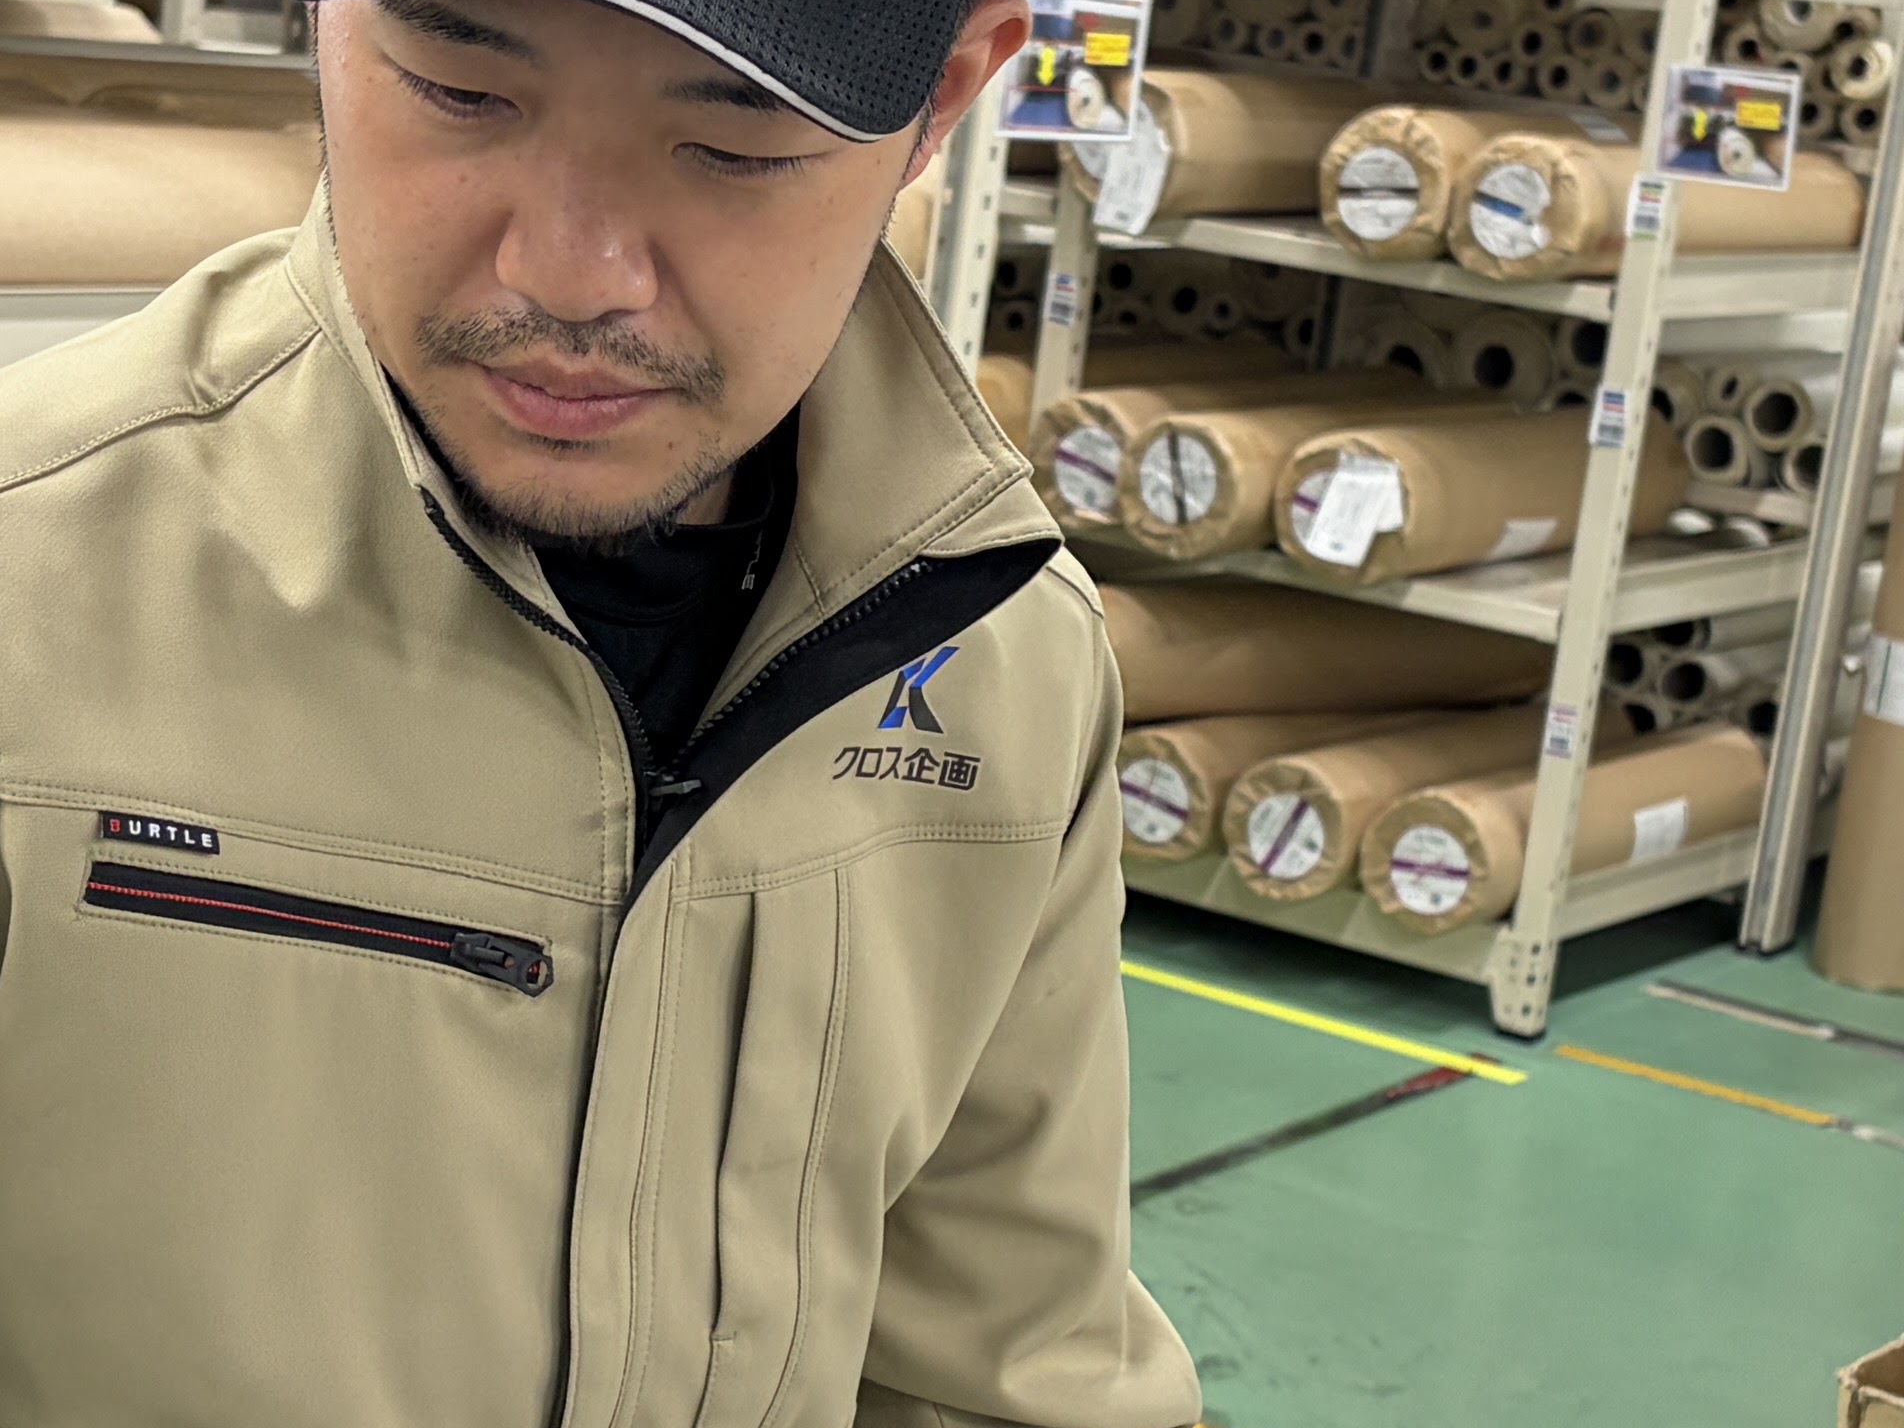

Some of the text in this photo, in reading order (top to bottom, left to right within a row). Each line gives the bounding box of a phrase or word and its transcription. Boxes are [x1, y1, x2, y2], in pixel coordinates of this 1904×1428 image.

[831, 746, 981, 791] クロス企画
[108, 818, 214, 849] BURTLE
